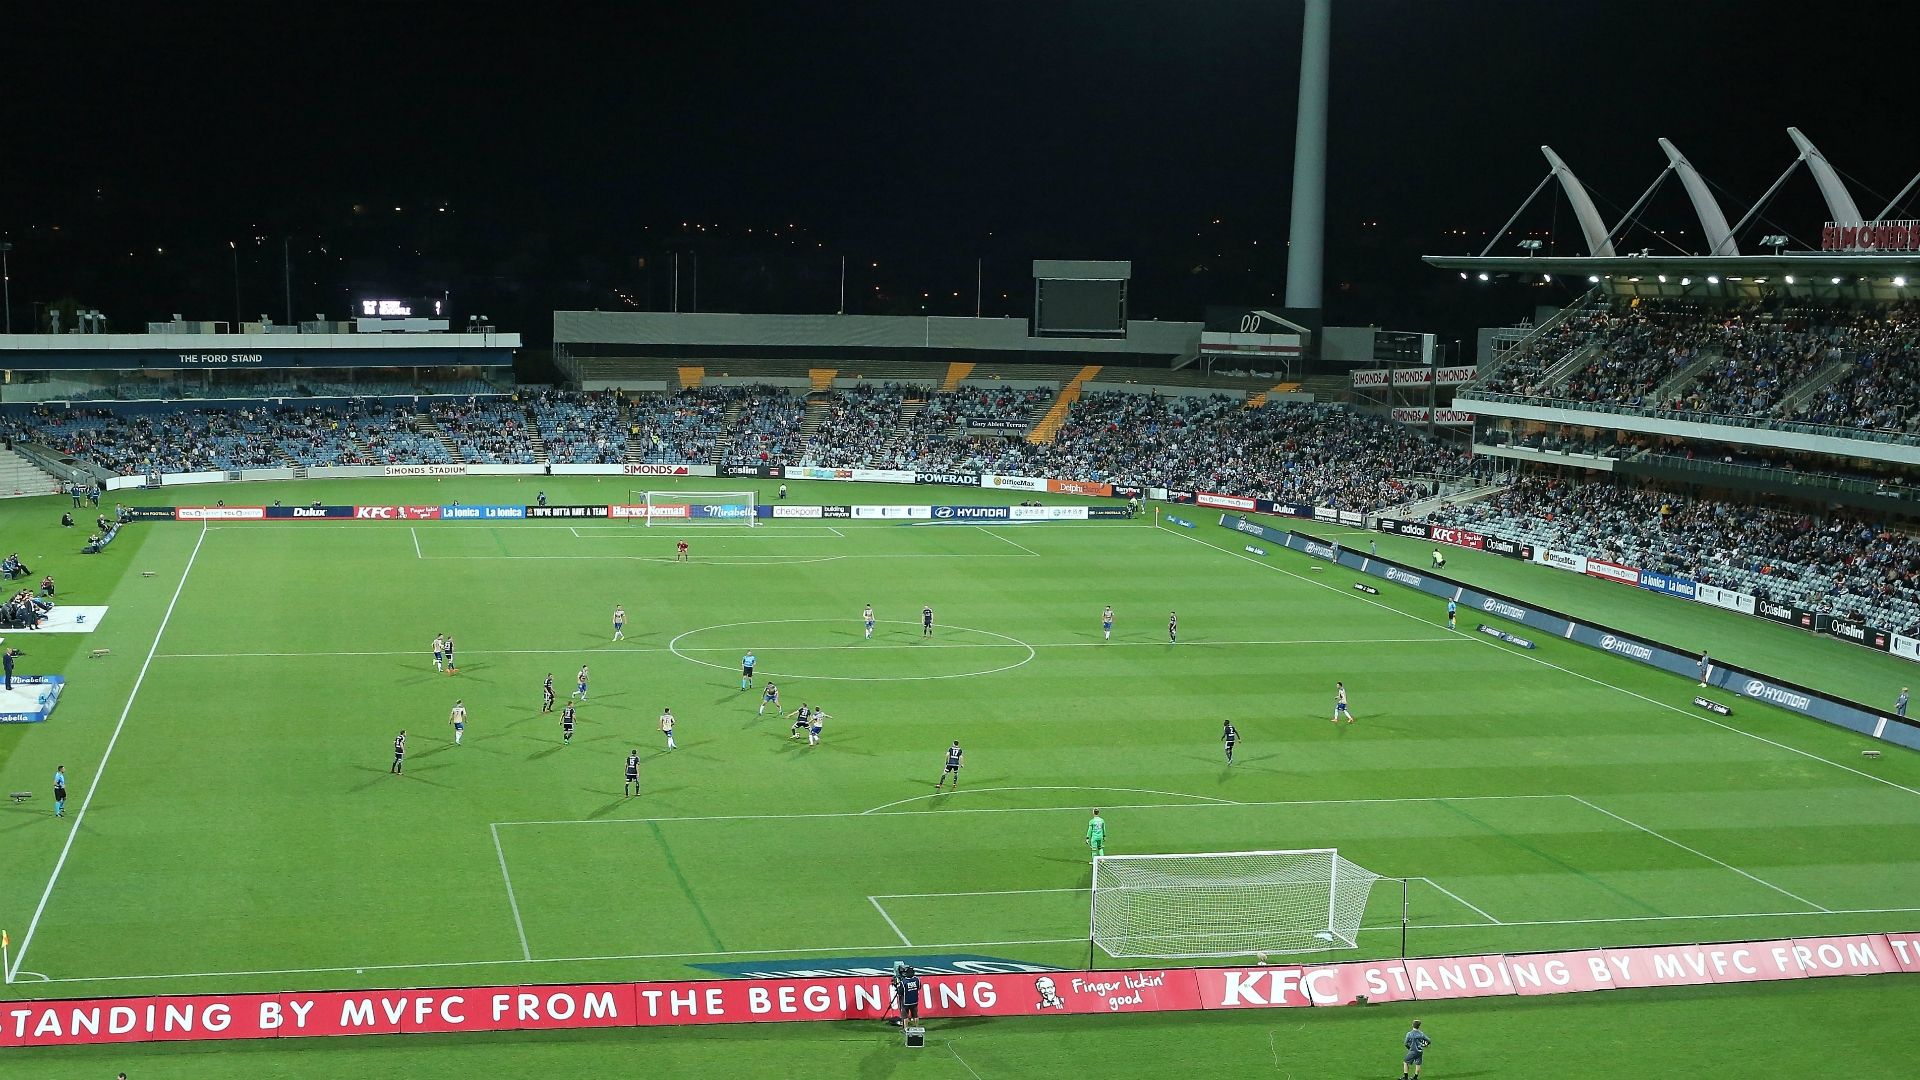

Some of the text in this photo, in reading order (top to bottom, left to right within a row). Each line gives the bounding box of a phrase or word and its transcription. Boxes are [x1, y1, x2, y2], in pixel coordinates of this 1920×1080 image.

[1821, 225, 1920, 249] SIMONDS
[179, 354, 262, 363] THE FORD STAND
[1355, 374, 1382, 385] SIMONDS
[1394, 371, 1423, 384] SIMONDS
[1437, 369, 1469, 382] SIMONDS
[1393, 410, 1420, 422] SIMONDS
[1435, 410, 1466, 422] SIMONDS
[972, 420, 986, 428] Gary
[385, 466, 465, 475] SIMONDS STADIUM
[625, 465, 672, 474] SIMONDS
[917, 473, 980, 485] POWERADE
[1002, 478, 1034, 487] OfficeMax
[293, 507, 326, 517] Dulux
[356, 507, 392, 518] KFC
[443, 508, 454, 517] La
[486, 508, 496, 517] La
[533, 507, 608, 517] YOU'VE GOTTA HAVE A TEAM
[612, 505, 685, 516] Harvey Norman
[703, 505, 757, 517] Mirabella
[775, 506, 820, 516] checkpoint
[957, 509, 1007, 517] HYUNDAI
[1273, 503, 1296, 516] Dulux
[1401, 524, 1425, 536] adidas
[1432, 528, 1455, 542] KFC
[1486, 538, 1513, 553] Optislim
[1549, 553, 1577, 566] OfficeMax
[1395, 570, 1422, 587] HYUNDAI
[1641, 574, 1648, 585] La
[1669, 580, 1676, 591] La
[1495, 602, 1526, 620] HYUNDAI
[1759, 600, 1792, 620] Optislim
[1831, 619, 1865, 640] Optislim
[1615, 640, 1653, 661] HYUNDAI
[10, 676, 49, 685] Mirabella
[1764, 686, 1811, 711] HYUNDAI
[1365, 960, 1570, 995] STANDING
[1594, 955, 1633, 983] BY
[1655, 948, 1757, 978] MVFC
[1772, 942, 1880, 972] FROM
[1073, 971, 1165, 995] Finger lickin'
[1221, 969, 1338, 1006] KFC
[1109, 994, 1142, 1007] good
[0, 1005, 231, 1039] TANDING
[259, 1000, 315, 1030] BY
[340, 996, 466, 1027] MVFC
[492, 991, 617, 1022] FROM
[642, 989, 724, 1018] THE
